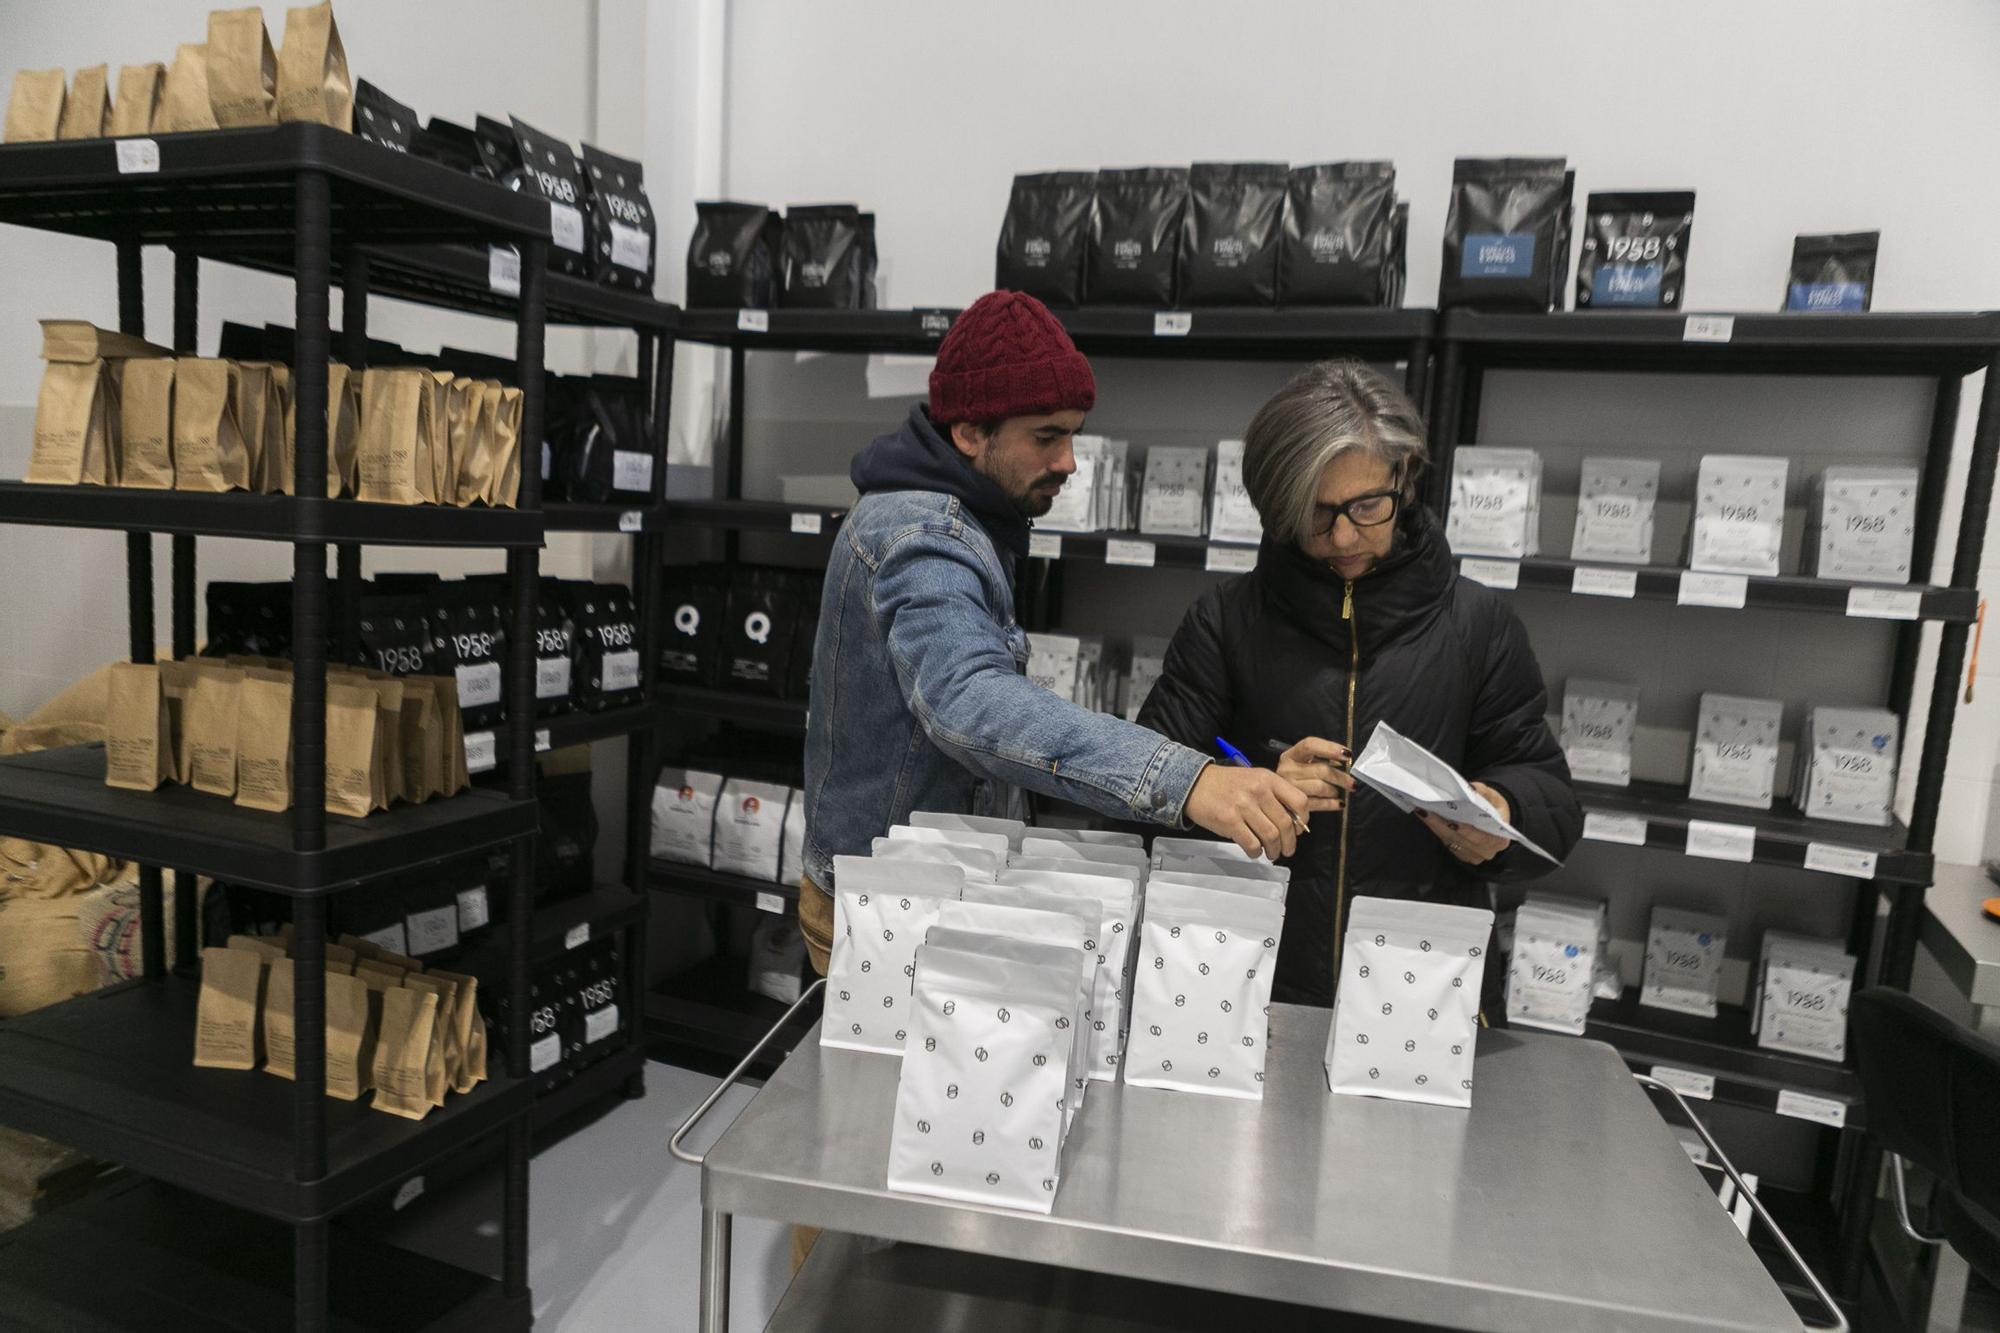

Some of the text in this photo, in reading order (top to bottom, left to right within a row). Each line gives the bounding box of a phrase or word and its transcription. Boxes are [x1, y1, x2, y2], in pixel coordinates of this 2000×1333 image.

[536, 170, 575, 203] 1958
[605, 195, 640, 223] 1958
[1606, 235, 1661, 262] 1958
[1158, 483, 1184, 497] 1958
[1470, 495, 1503, 511] 1958
[1598, 503, 1631, 520] 1958
[1720, 505, 1757, 522] 1958
[1845, 515, 1885, 532] 1958
[674, 604, 700, 636] Q
[744, 611, 771, 644] Q
[452, 632, 491, 659] 1958
[599, 624, 631, 647] 1958
[377, 646, 423, 672] 1958
[1580, 723, 1612, 741] 1958
[1716, 743, 1752, 760] 1958
[1834, 754, 1872, 773] 1958
[1666, 951, 1700, 970] 1958
[1531, 964, 1566, 985] 1958
[580, 979, 613, 1009] 1958
[1788, 990, 1825, 1011] 1958
[531, 1006, 556, 1034] 58
